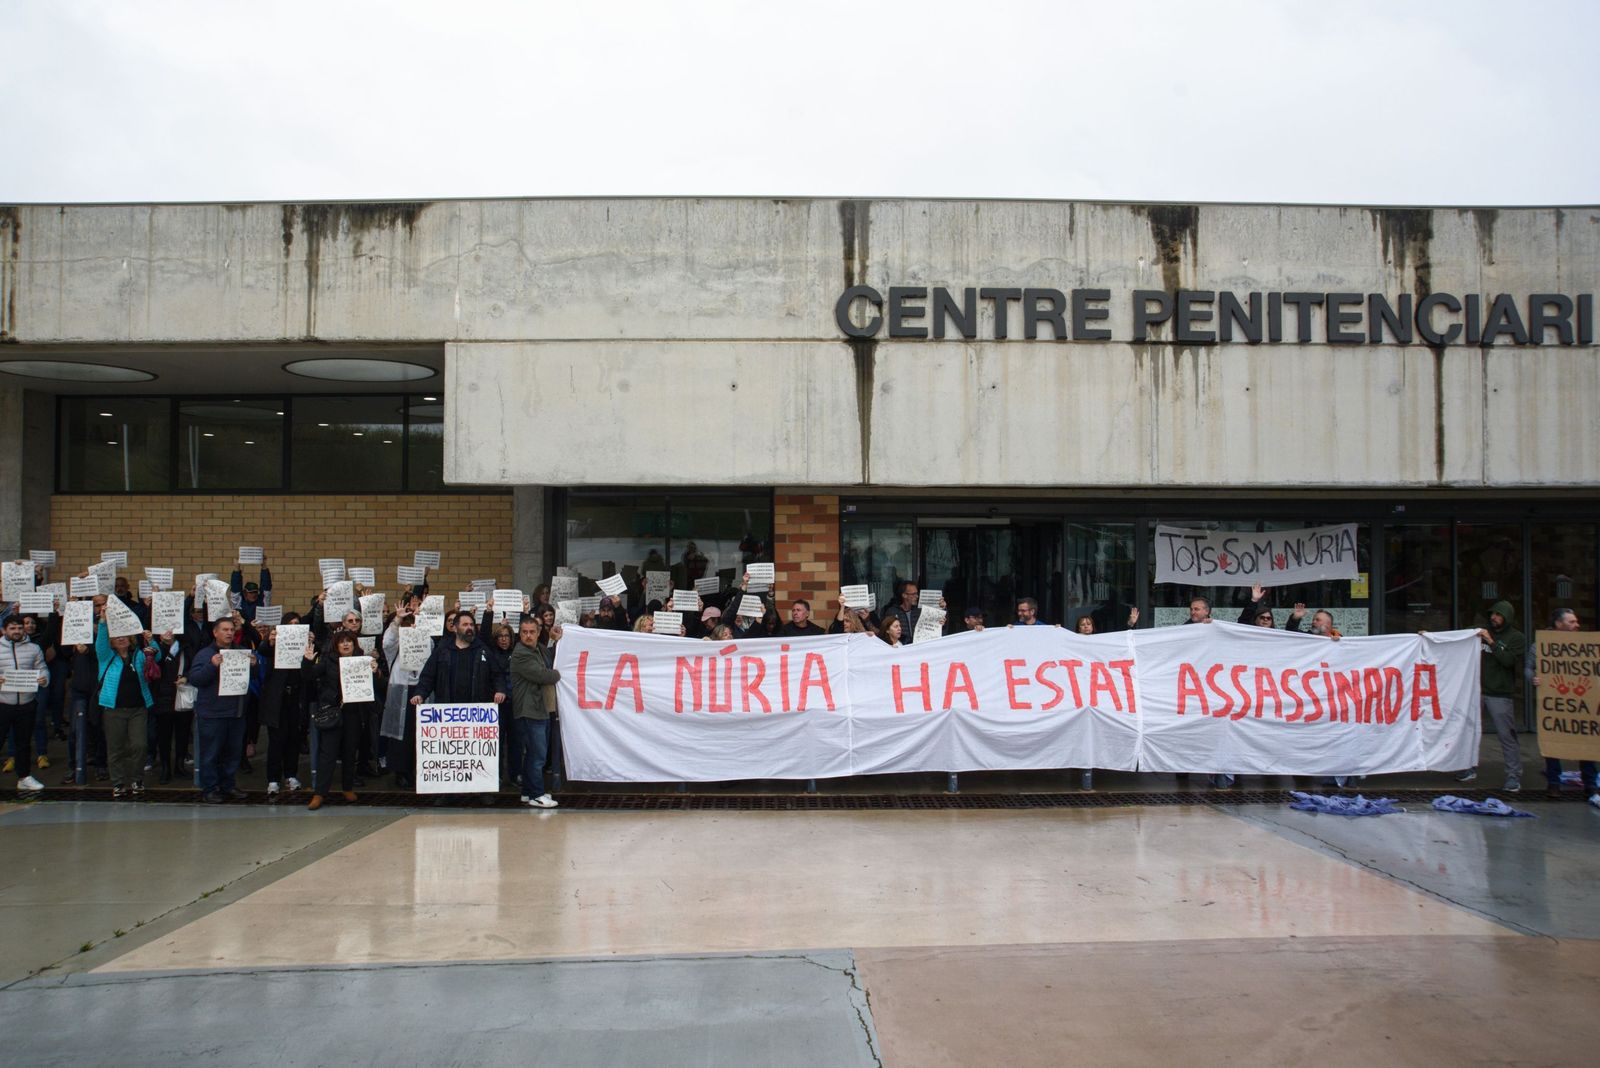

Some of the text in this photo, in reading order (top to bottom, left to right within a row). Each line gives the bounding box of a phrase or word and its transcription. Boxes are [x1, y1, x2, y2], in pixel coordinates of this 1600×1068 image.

[836, 285, 1592, 345] CENTRE PENITENCIARI
[1284, 529, 1356, 569] NÚRIA
[576, 643, 1443, 724] LA NÚRIA HA ESTAT ASSASSINADA
[1542, 696, 1590, 714] CESA
[421, 706, 499, 723] SIN SEGURIDAD
[422, 726, 499, 740] NO PUEDE HABER
[1542, 716, 1600, 736] CALDER
[422, 739, 497, 756] REINSERCIÓN
[422, 759, 485, 770] CONSEJERA
